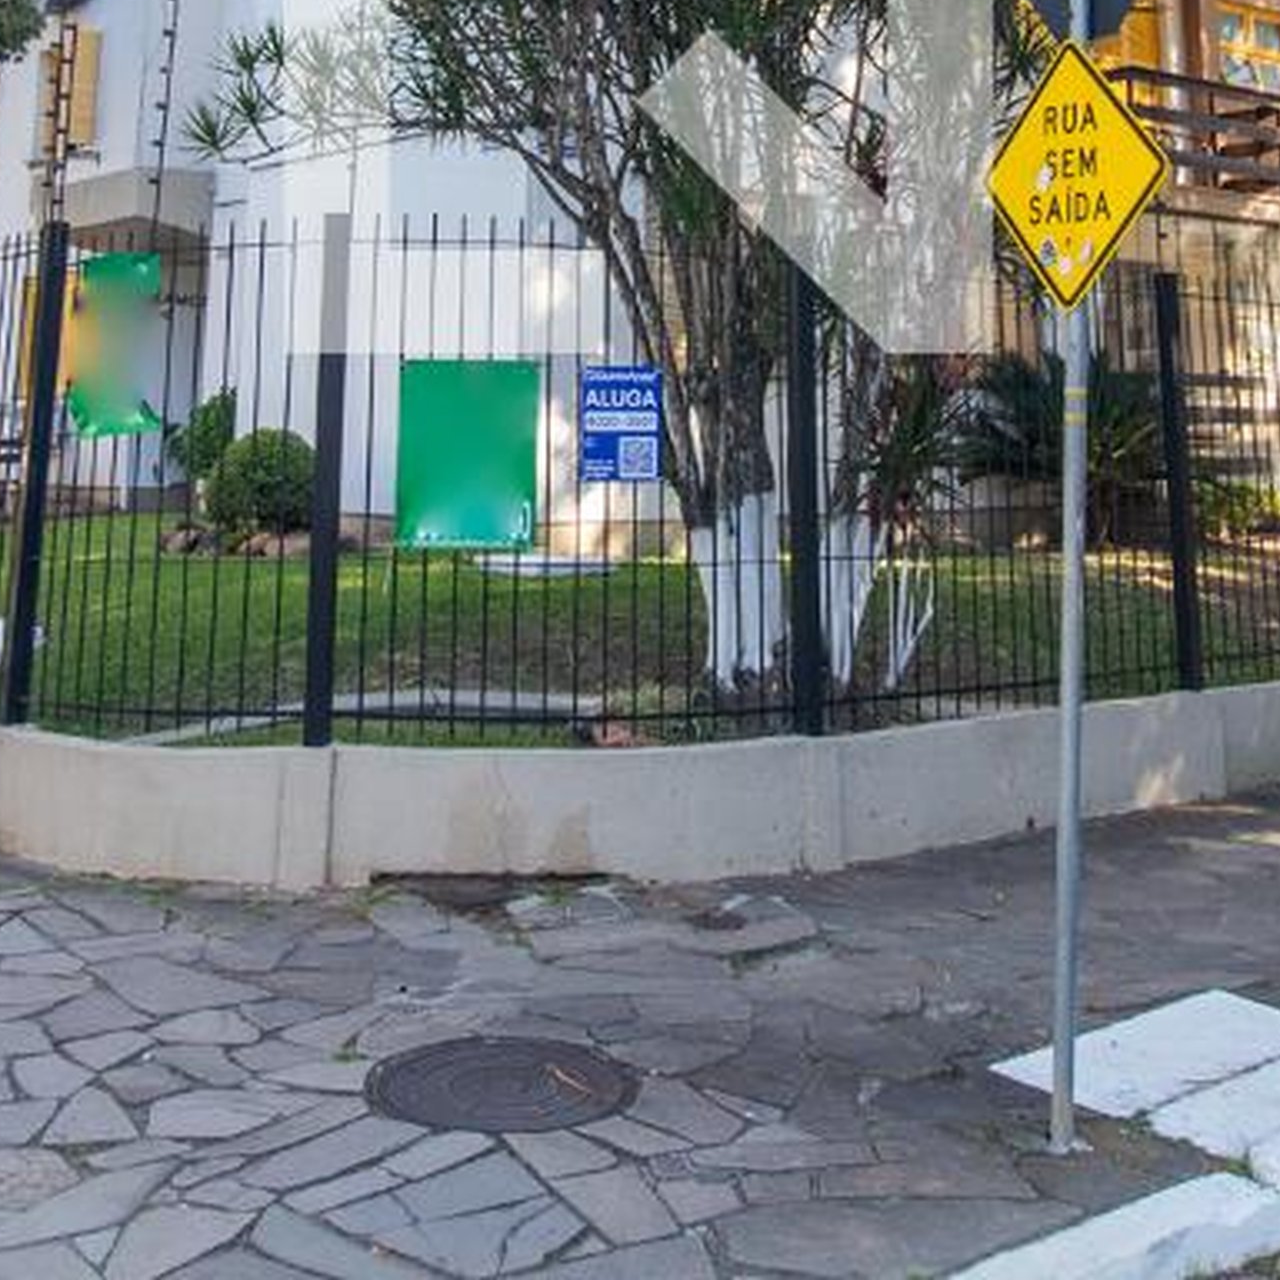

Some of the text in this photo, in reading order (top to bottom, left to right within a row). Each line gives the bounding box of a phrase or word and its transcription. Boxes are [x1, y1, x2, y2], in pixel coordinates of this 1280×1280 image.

[1042, 104, 1099, 135] RUA
[1044, 148, 1098, 182] SEM
[1028, 187, 1112, 224] SAÍDA
[585, 389, 658, 408] ALUGA
